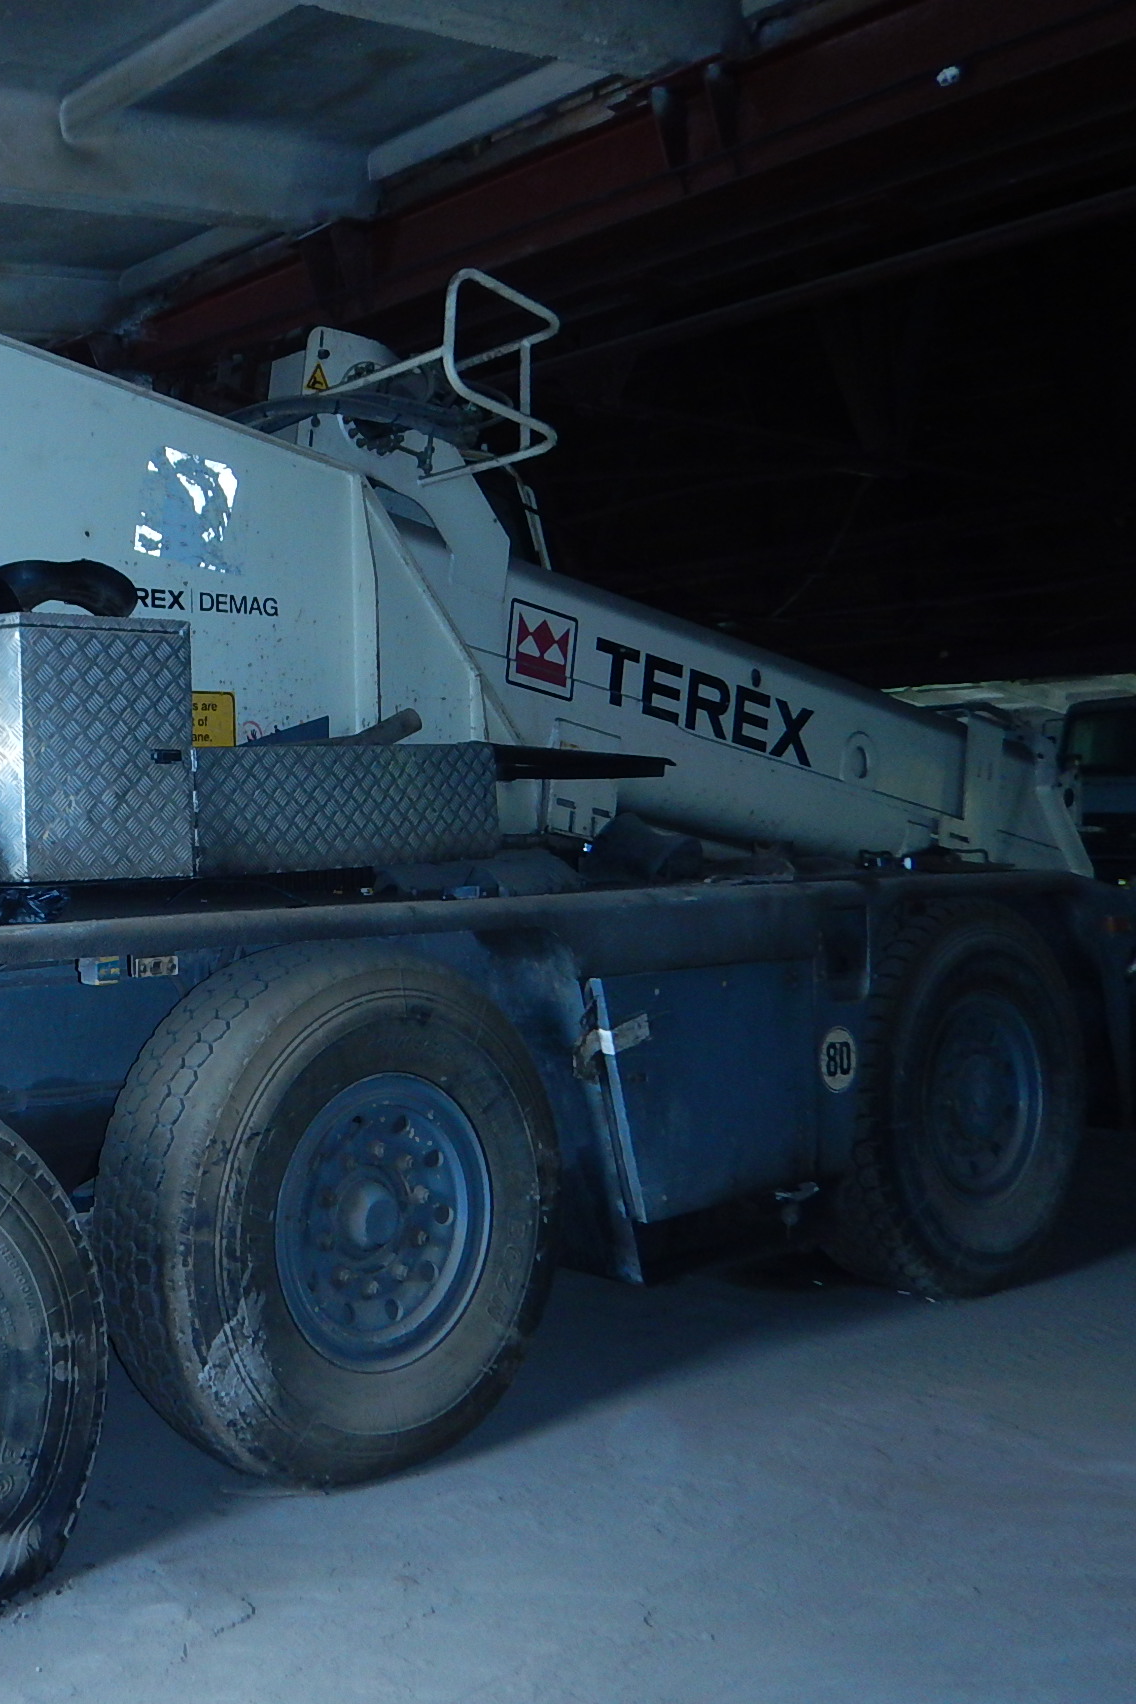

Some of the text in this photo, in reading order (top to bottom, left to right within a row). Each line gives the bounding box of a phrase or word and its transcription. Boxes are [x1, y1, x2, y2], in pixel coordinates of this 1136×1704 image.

[199, 592, 279, 617] DEMAG
[201, 702, 218, 712] are
[596, 637, 814, 768] TEREX
[197, 716, 208, 727] of
[826, 1041, 851, 1077] 80
